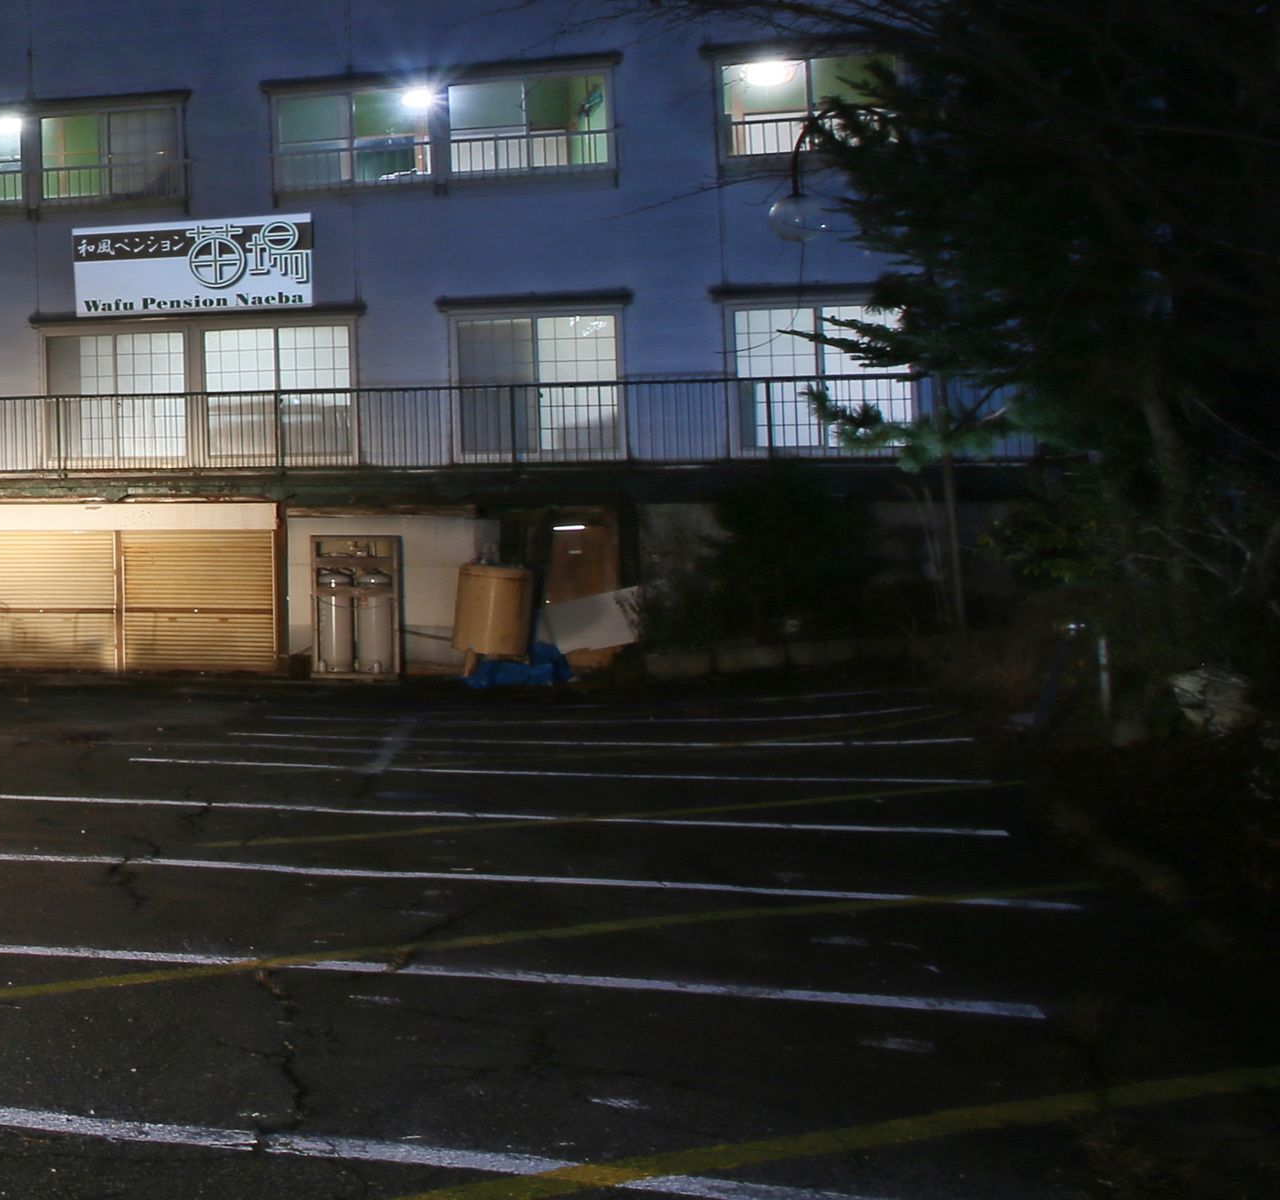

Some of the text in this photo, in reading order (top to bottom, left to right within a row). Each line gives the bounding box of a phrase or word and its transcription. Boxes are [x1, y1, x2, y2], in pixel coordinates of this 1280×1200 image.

[77, 235, 185, 257] 和風ペンション
[83, 292, 304, 313] Wafu Pension Naeba
